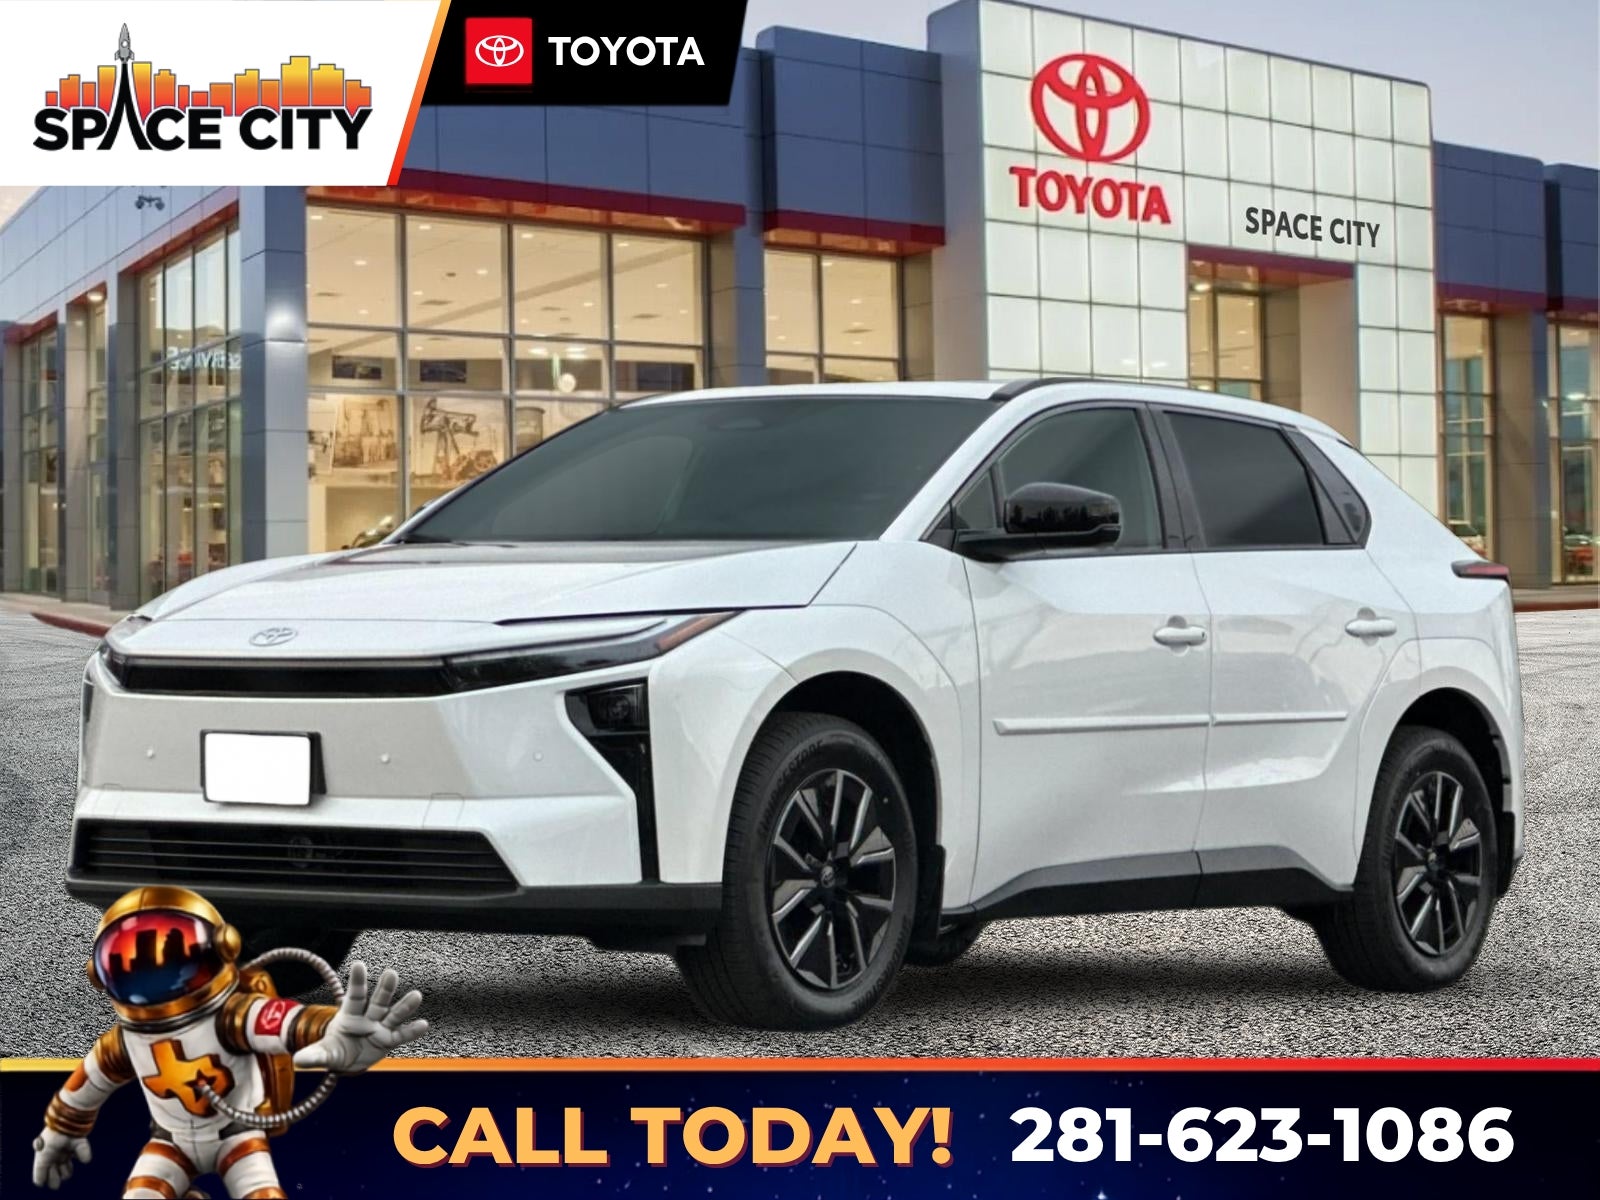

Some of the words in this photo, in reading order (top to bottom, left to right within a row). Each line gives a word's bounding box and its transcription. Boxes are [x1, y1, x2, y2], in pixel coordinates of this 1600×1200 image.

[1009, 166, 1171, 224] TOYOTA
[1245, 206, 1323, 242] SPACE
[1329, 217, 1381, 248] CITY
